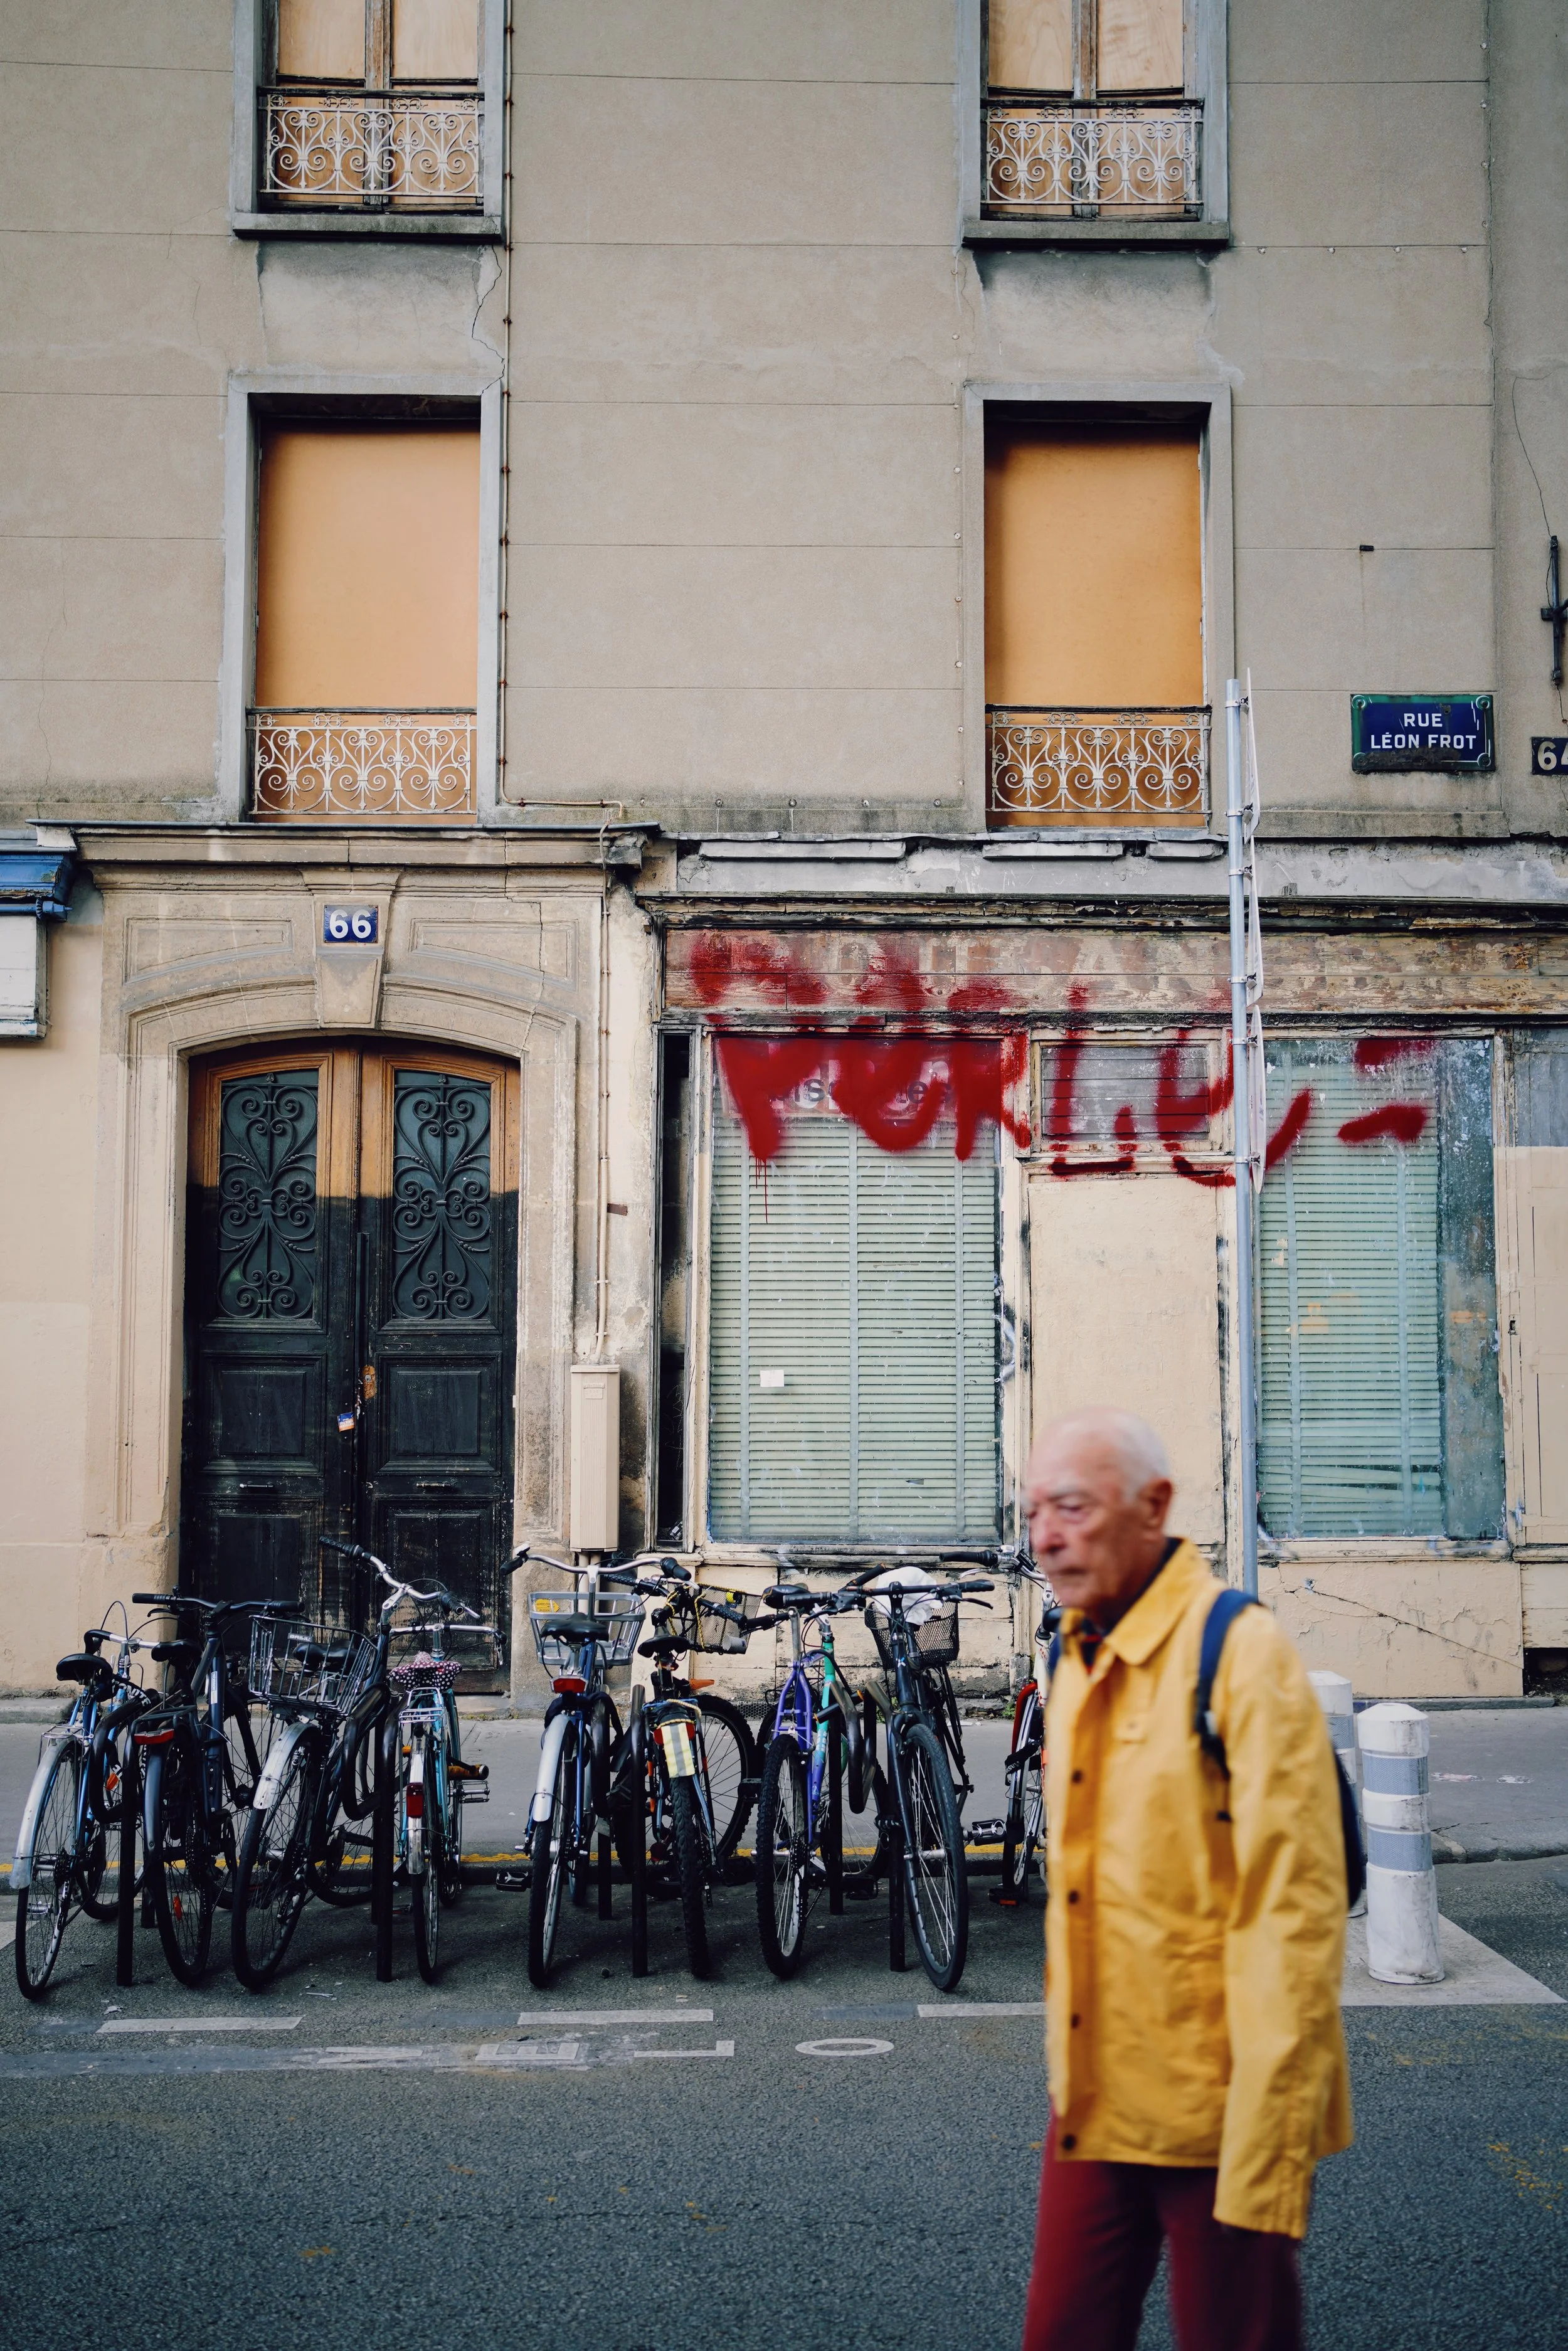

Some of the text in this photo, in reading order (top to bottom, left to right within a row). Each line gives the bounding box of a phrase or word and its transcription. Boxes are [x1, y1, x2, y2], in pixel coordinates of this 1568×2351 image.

[1404, 713, 1443, 727] RUE
[1371, 732, 1476, 749] LÉON FROT
[329, 909, 371, 939] 66
